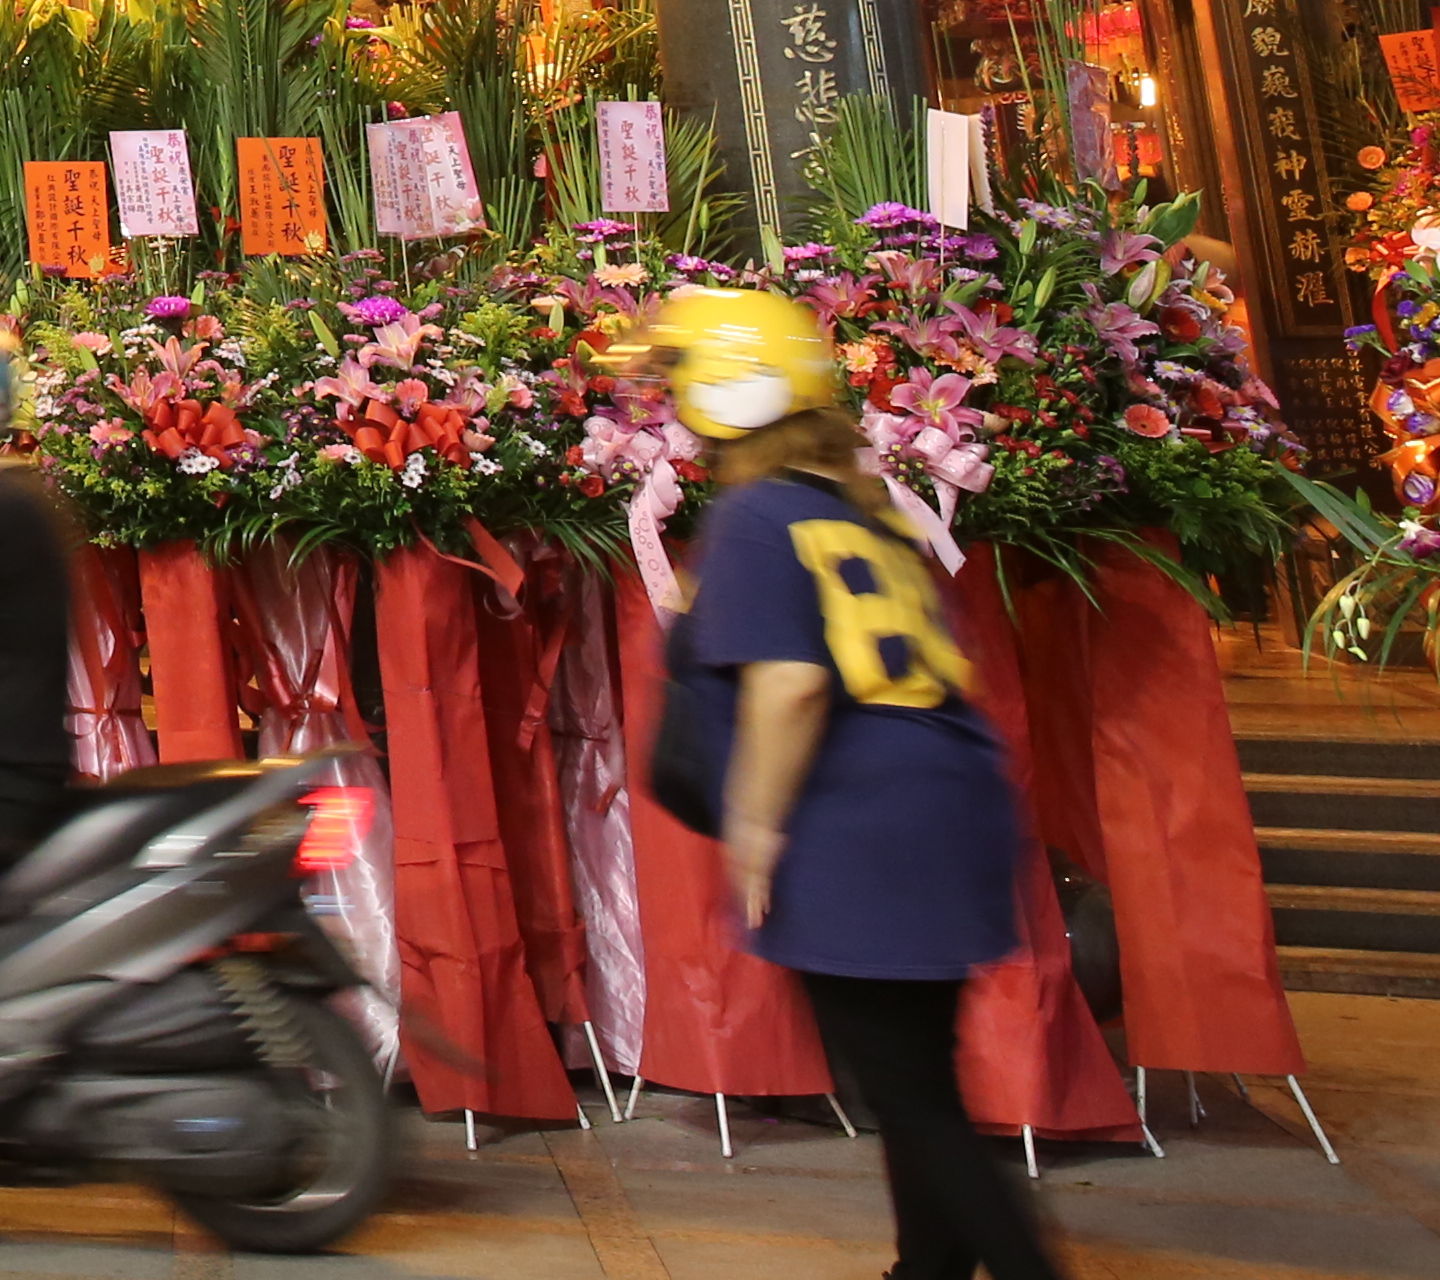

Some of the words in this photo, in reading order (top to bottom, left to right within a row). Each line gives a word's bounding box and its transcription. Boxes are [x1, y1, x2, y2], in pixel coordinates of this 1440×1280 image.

[167, 133, 185, 165] 恭祝
[408, 128, 422, 163] 恭祝
[621, 120, 642, 203] 聖誕千秋
[645, 104, 660, 139] 恭祝
[150, 145, 176, 224] 聖誕千秋
[278, 145, 304, 242] 聖誕千秋
[396, 141, 417, 221] 聖誕千秋
[421, 127, 454, 211] 聖誕千秋
[63, 169, 88, 266] 聖誕千秋
